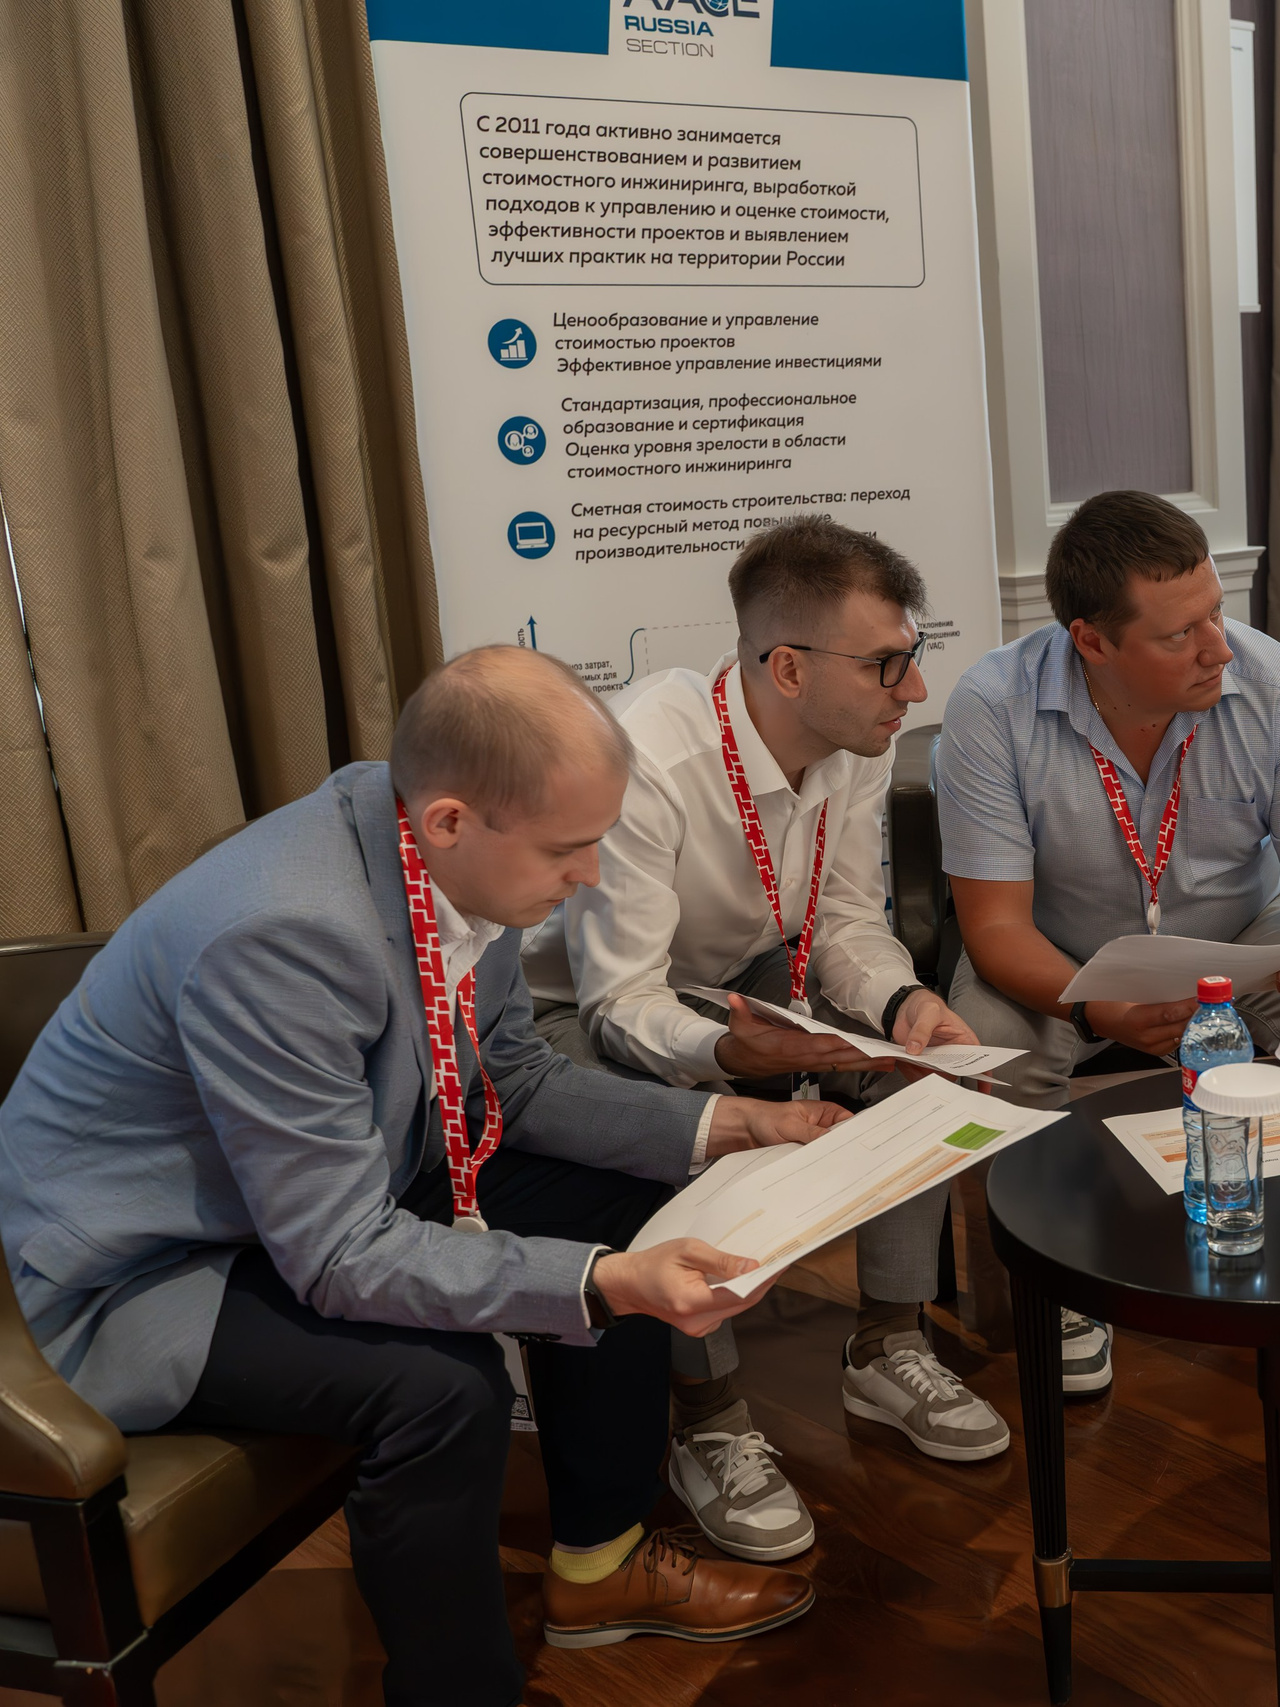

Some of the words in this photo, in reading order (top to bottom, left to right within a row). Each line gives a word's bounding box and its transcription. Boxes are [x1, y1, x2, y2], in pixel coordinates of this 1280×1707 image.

[624, 15, 714, 37] RUSSIA
[626, 38, 714, 58] SECTION
[476, 114, 489, 132] С
[495, 116, 540, 134] 2011
[545, 122, 590, 138] года
[595, 125, 672, 140] активно
[677, 129, 780, 145] занимается
[479, 146, 687, 165] совершенствованием
[692, 154, 702, 166] и
[707, 155, 800, 170] развитием
[482, 172, 615, 188] стоимостного
[620, 177, 748, 195] инжиниринга,
[753, 180, 856, 197] выработкой
[485, 198, 579, 214] подходов
[584, 201, 595, 212] к
[599, 201, 715, 217] управлению
[720, 205, 730, 216] и
[735, 205, 796, 219] оценке
[800, 207, 889, 222] стоимости,
[488, 220, 635, 241] эффективности
[640, 227, 724, 243] проектов
[729, 229, 739, 240] и
[744, 230, 848, 242] выявлением
[490, 250, 564, 267] лучших
[569, 251, 646, 267] практик
[650, 252, 672, 264] на
[677, 252, 781, 268] территории
[786, 250, 844, 266] России
[553, 312, 708, 329] Ценообразование
[711, 315, 721, 326] и
[725, 315, 818, 329] управление
[554, 338, 656, 349] стоимостью
[660, 337, 735, 351] проектов
[556, 357, 671, 375] Эффективное
[675, 358, 771, 373] управление
[774, 356, 882, 368] инвестициями
[560, 397, 703, 413] Стандартизация,
[708, 393, 856, 410] профессиональное
[562, 420, 674, 436] образование
[678, 419, 688, 430] и
[691, 414, 804, 432] сертификация
[564, 441, 629, 457] Оценка
[633, 441, 692, 457] уровня
[695, 438, 768, 454] зрелости
[771, 438, 780, 448] в
[784, 433, 846, 447] области
[566, 463, 681, 478] стоимостного
[685, 458, 791, 473] инжиниринга
[570, 502, 642, 517] Сметная
[646, 499, 728, 512] стоимость
[731, 492, 846, 510] строительства:
[850, 488, 910, 503] переход
[573, 527, 594, 538] на
[598, 519, 688, 540] ресурсный
[691, 517, 740, 532] метод
[574, 542, 746, 563] производительности
[926, 642, 945, 652] (VAC)
[584, 660, 613, 670] затрат,
[602, 672, 618, 681] для
[592, 683, 624, 693] проекта
